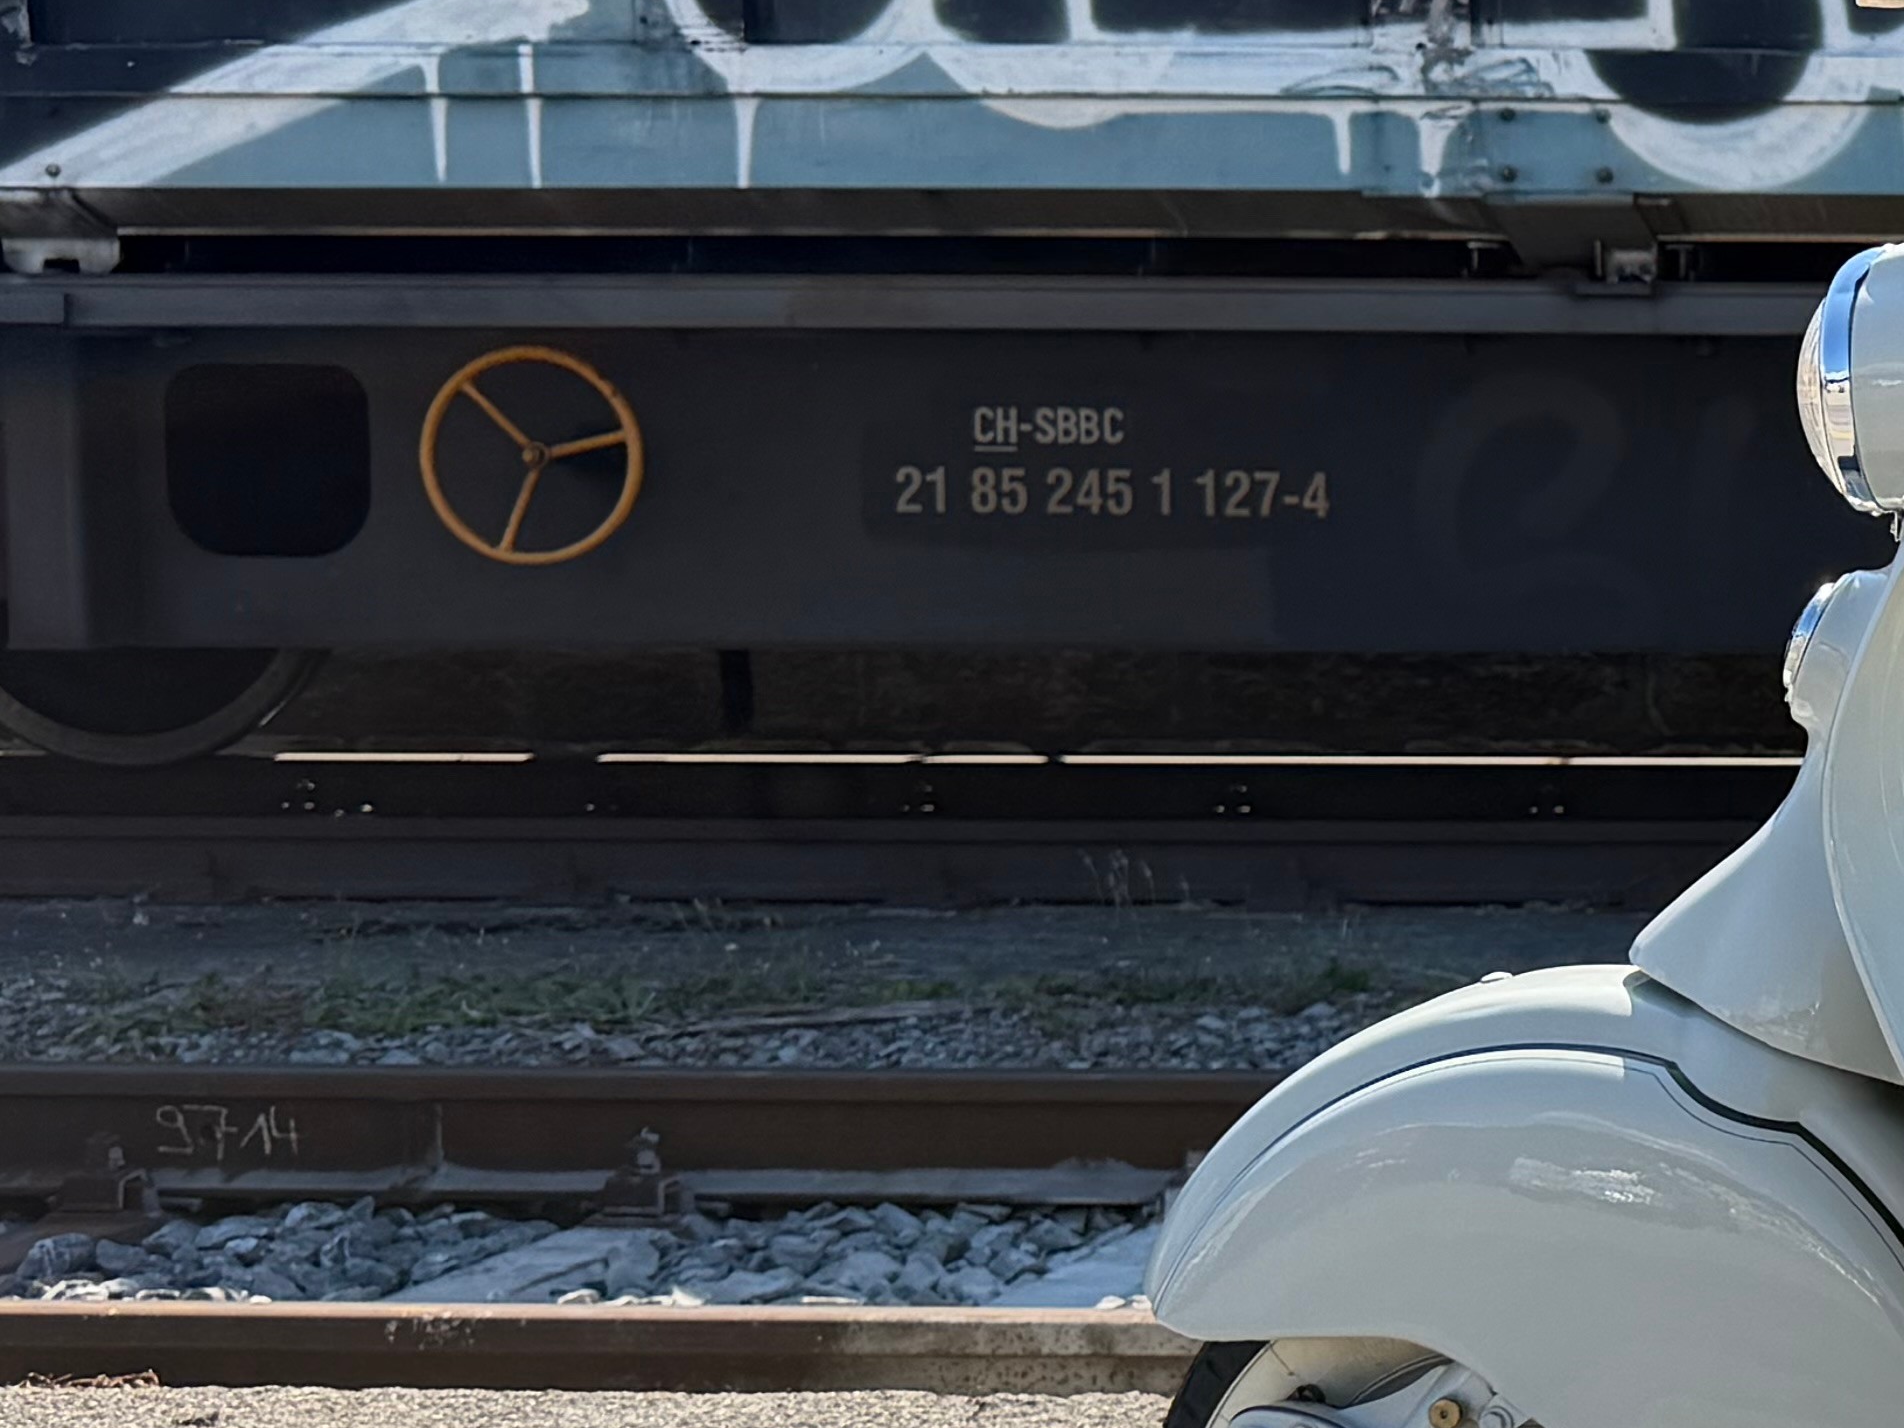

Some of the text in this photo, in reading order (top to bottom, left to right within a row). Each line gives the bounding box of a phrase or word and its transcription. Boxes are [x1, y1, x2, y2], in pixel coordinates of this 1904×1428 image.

[973, 406, 1125, 445] CH-SBBC
[895, 466, 1330, 519] 21 85 245 1 127-4
